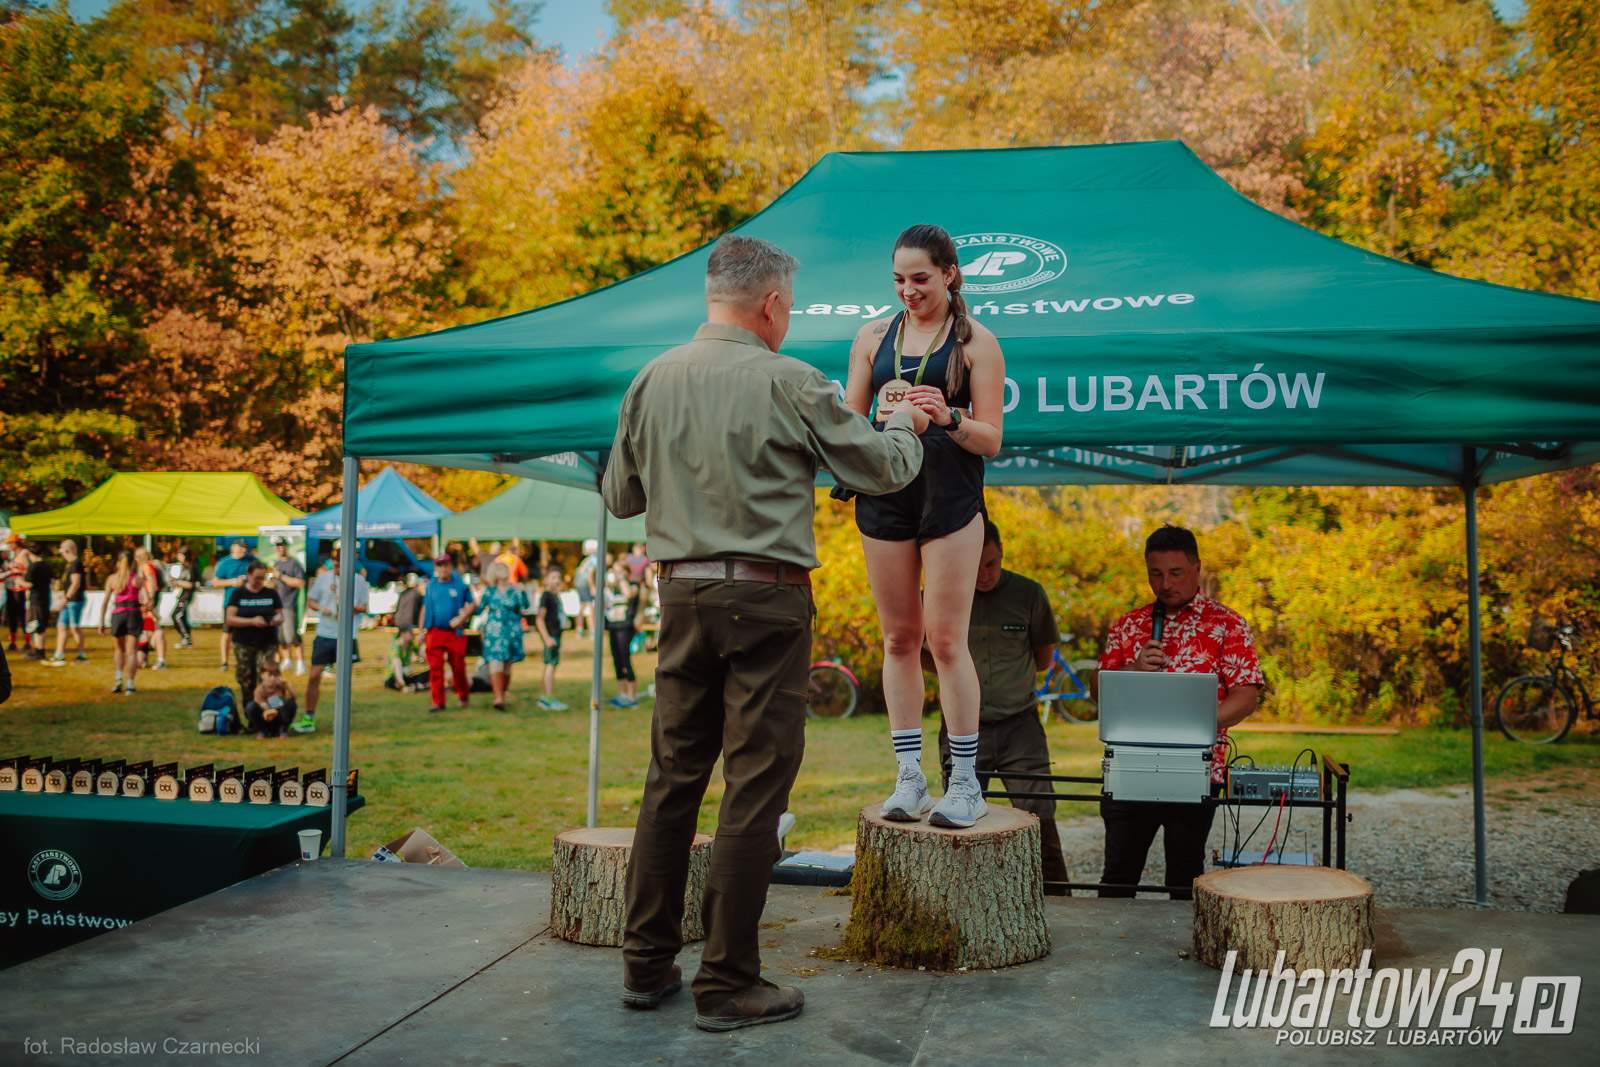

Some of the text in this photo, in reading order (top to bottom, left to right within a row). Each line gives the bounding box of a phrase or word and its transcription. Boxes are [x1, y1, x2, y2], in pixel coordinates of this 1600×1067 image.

[971, 292, 1196, 316] ństwowe
[1037, 362, 1326, 413] LUBARTÓW
[0, 908, 134, 929] sy Państwow
